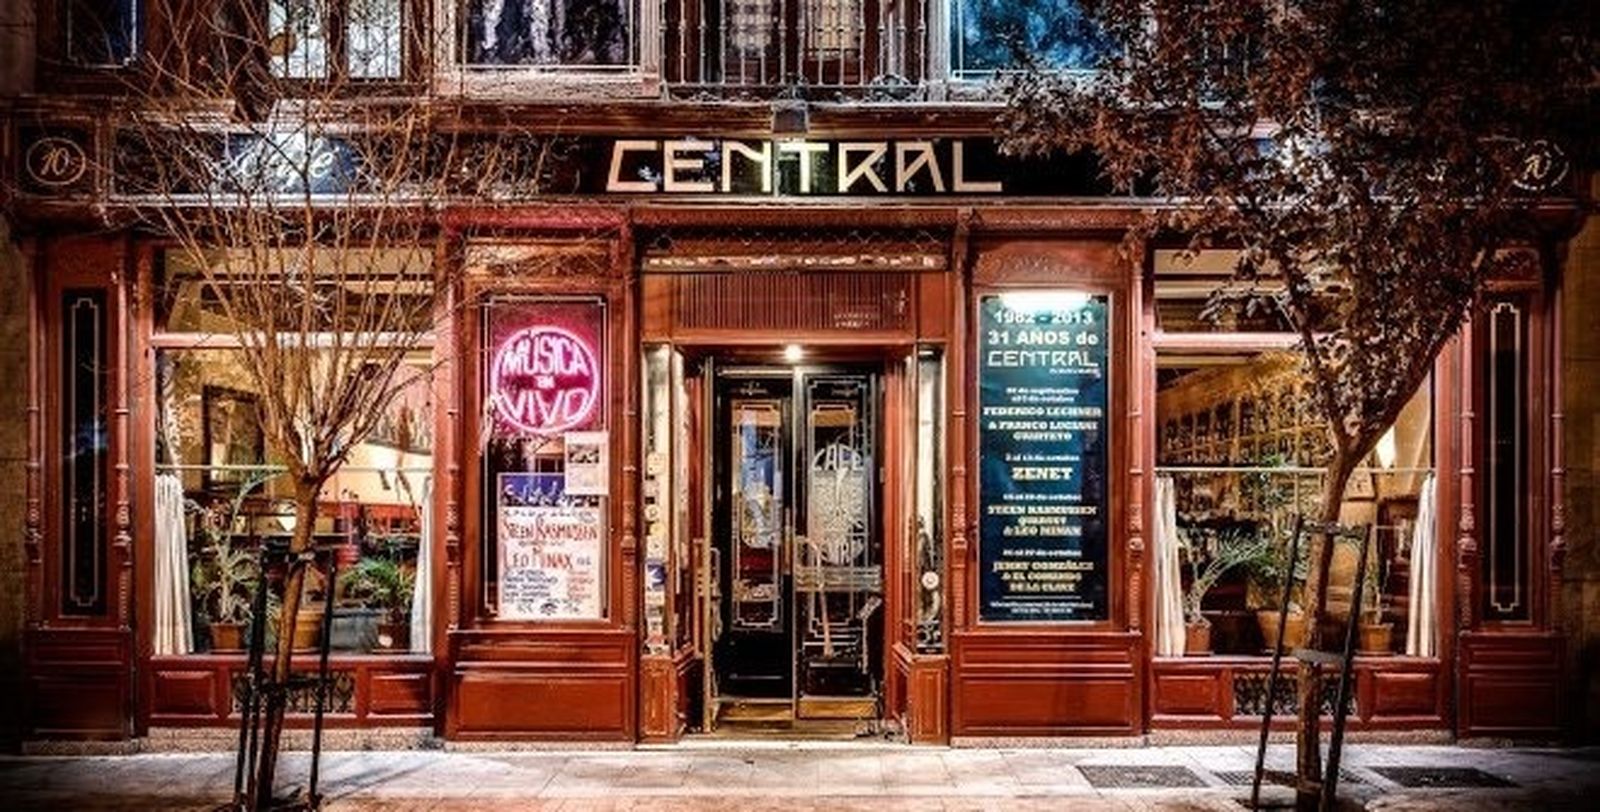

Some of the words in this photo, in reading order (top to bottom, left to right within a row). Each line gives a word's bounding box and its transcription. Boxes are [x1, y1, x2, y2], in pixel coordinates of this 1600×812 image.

[39, 145, 70, 177] 10
[606, 140, 1002, 192] CENTRAL
[988, 331, 1008, 346] 31
[1076, 331, 1099, 346] de
[987, 351, 1099, 367] CENTRAL
[500, 387, 589, 425] VIVO
[1012, 467, 1073, 481] ZENET
[1015, 526, 1037, 536] LEO
